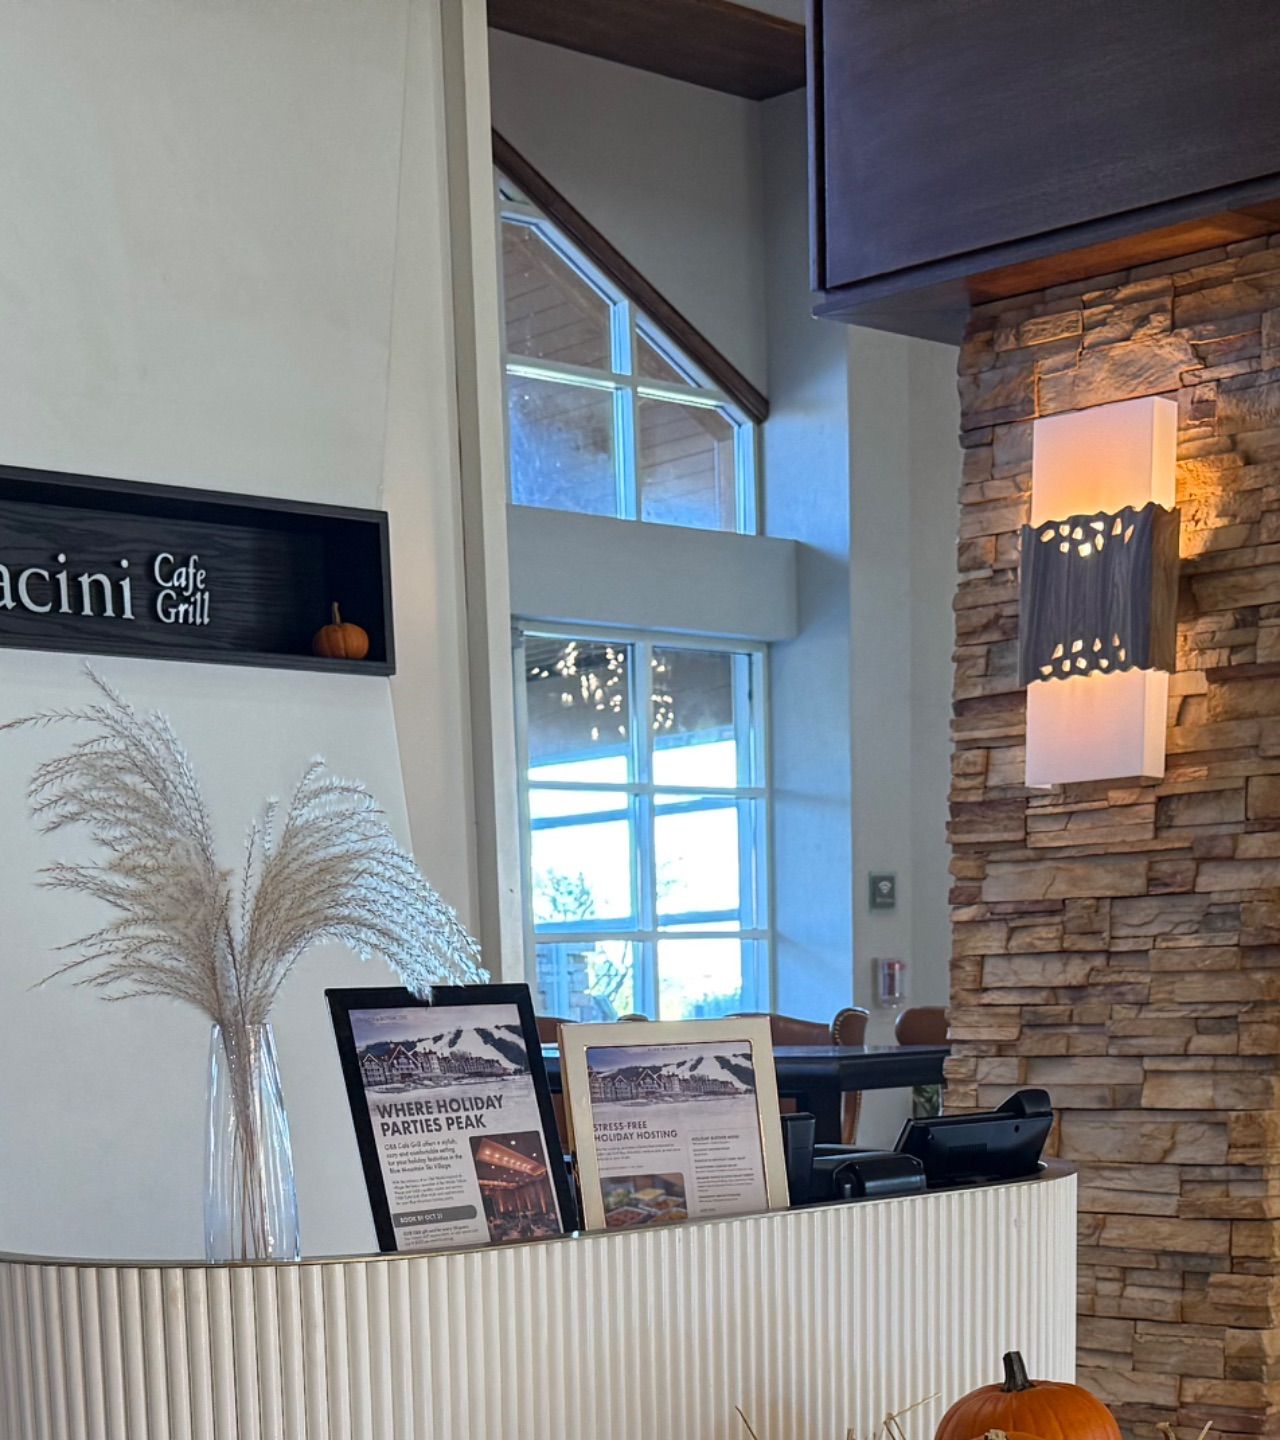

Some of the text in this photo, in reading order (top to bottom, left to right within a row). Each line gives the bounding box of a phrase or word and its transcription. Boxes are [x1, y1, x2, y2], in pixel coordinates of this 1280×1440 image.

[154, 552, 207, 596] Cafe
[156, 589, 211, 626] Grill
[376, 1094, 503, 1119] WHERE HOLIDAY
[381, 1114, 486, 1137] PARTIES PEAK
[593, 1120, 648, 1133] STRESS-FREE
[594, 1129, 678, 1142] HOLIDAY HOSTING
